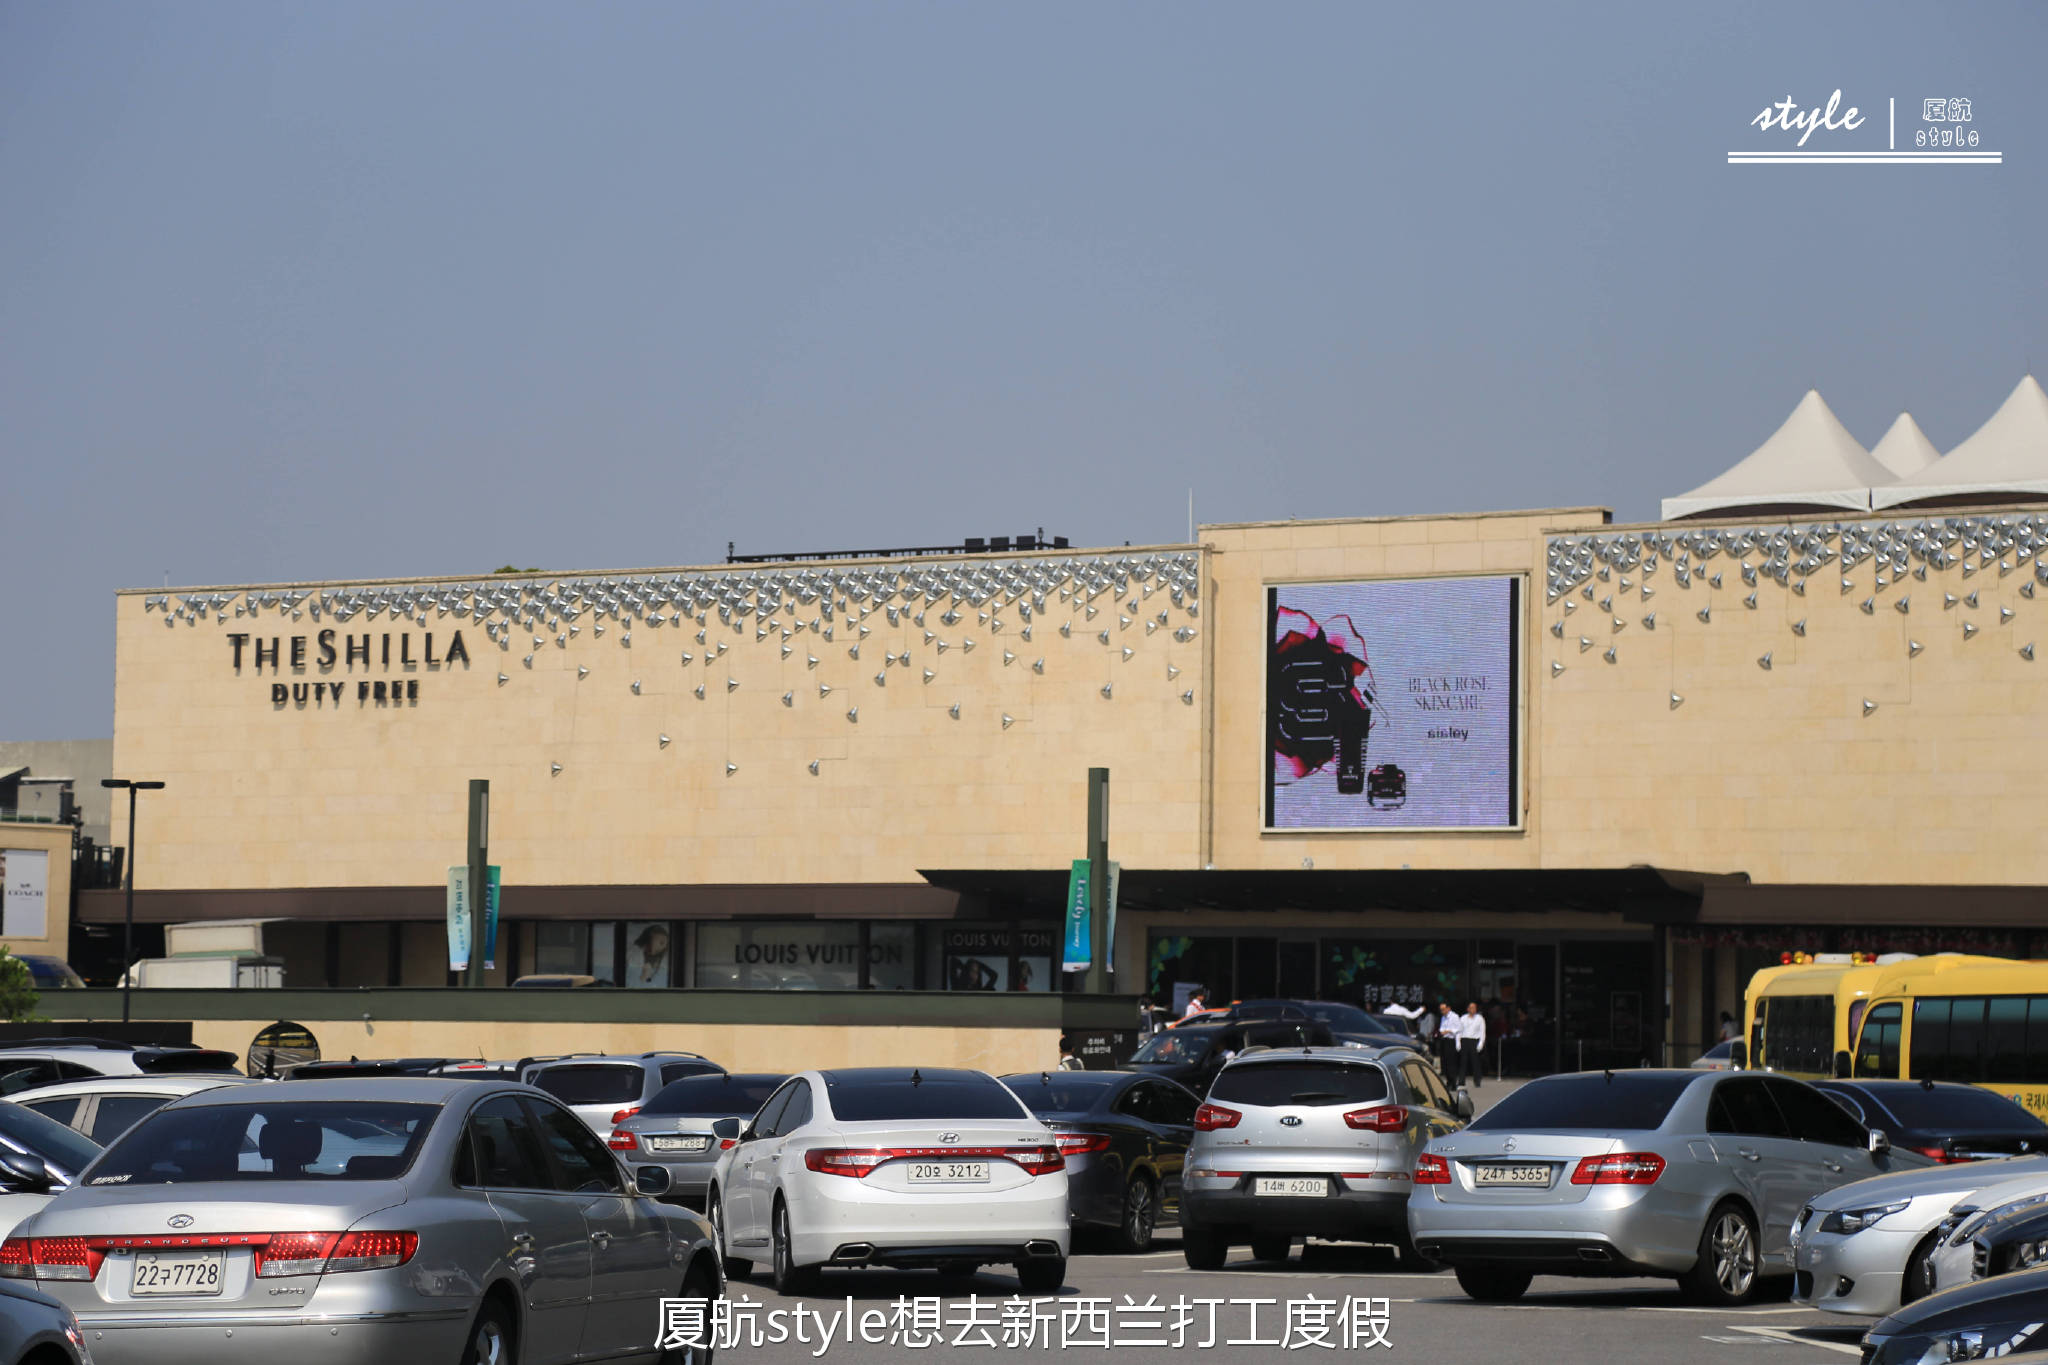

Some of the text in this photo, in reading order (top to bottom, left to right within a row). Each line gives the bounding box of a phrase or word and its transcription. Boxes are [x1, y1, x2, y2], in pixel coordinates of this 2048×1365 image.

[271, 680, 418, 702] DUTY FREE
[1408, 675, 1491, 693] BLACK ROSE
[1415, 694, 1483, 711] SKINCARE
[1427, 726, 1468, 741] sisley
[947, 932, 1051, 947] LOUIS VUTON
[735, 943, 902, 964] LOUIS VUITON
[948, 1164, 981, 1178] 3212
[1511, 1167, 1543, 1181] 5365
[1290, 1180, 1321, 1192] 6200
[106, 1236, 249, 1245] GRANDEUR
